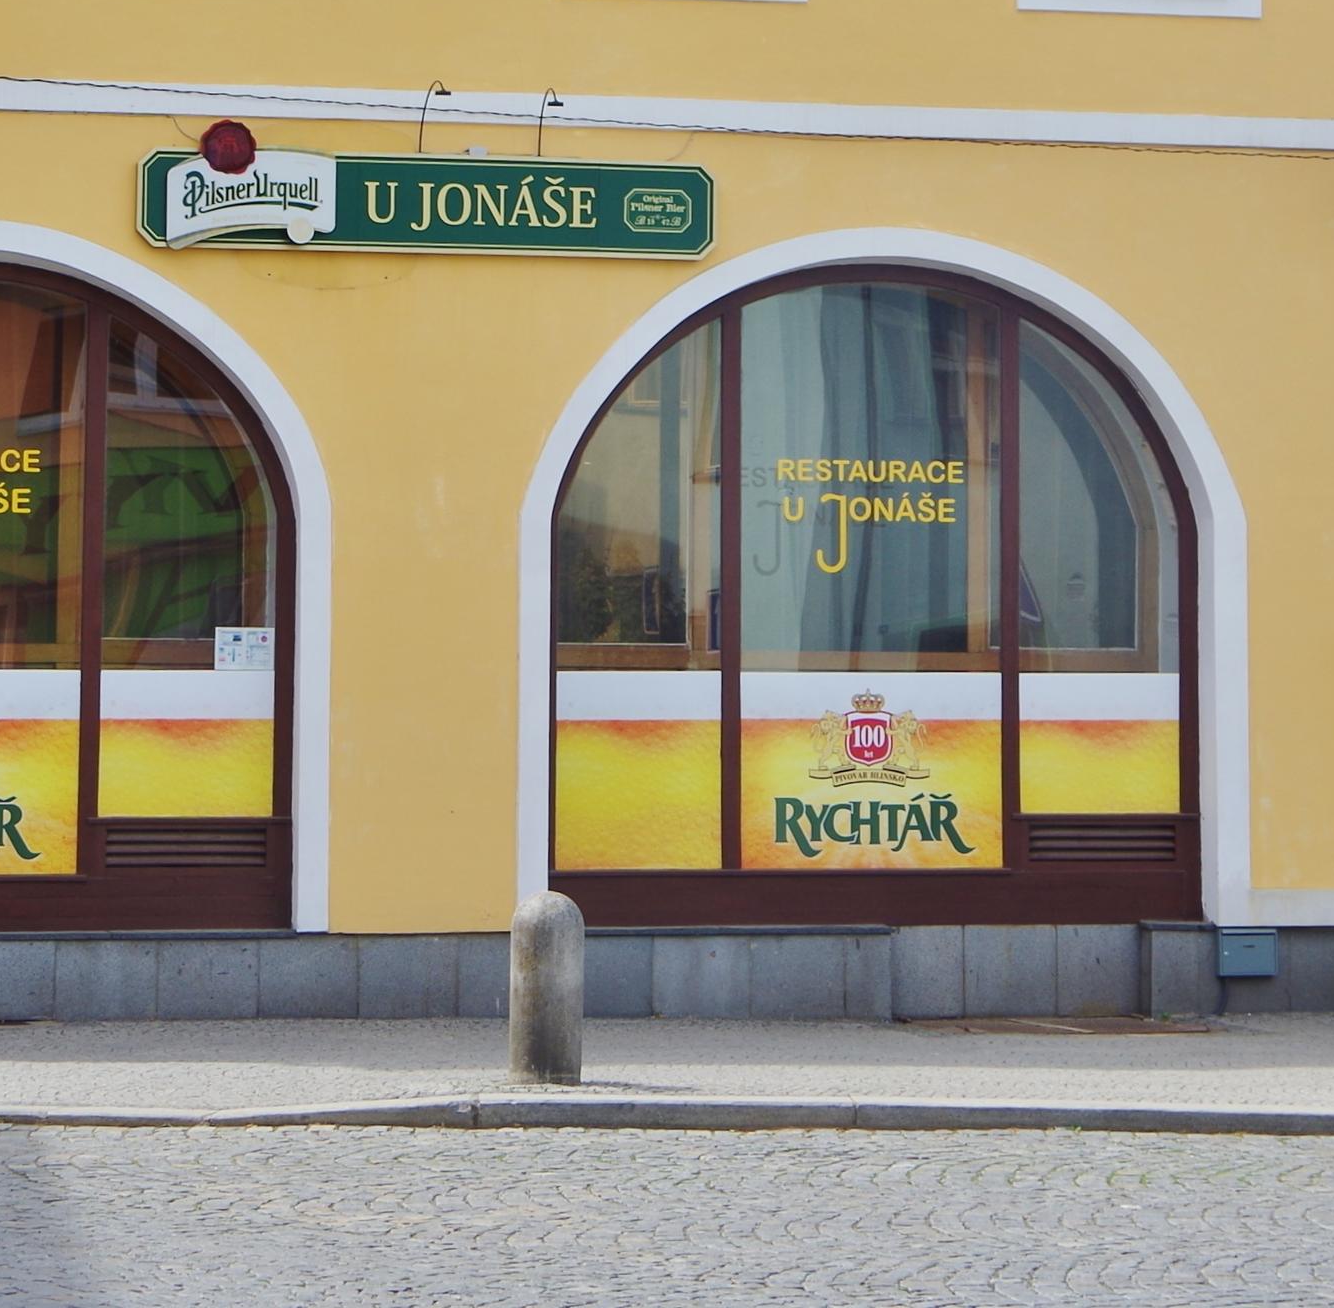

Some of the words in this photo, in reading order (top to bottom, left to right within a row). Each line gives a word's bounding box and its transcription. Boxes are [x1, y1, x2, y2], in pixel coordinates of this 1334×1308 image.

[182, 171, 254, 219] Pilsner
[253, 169, 319, 211] Urquell
[364, 181, 399, 224] U
[410, 174, 598, 231] JONÁŠE
[777, 458, 964, 484] RESTAURACE
[782, 496, 804, 522] U
[816, 492, 956, 573] JONÁŠE
[852, 724, 885, 748] 100
[834, 771, 867, 783] PIVOVAR
[870, 771, 904, 783] HLINSKO
[774, 793, 976, 858] RYCHTÁŘ
